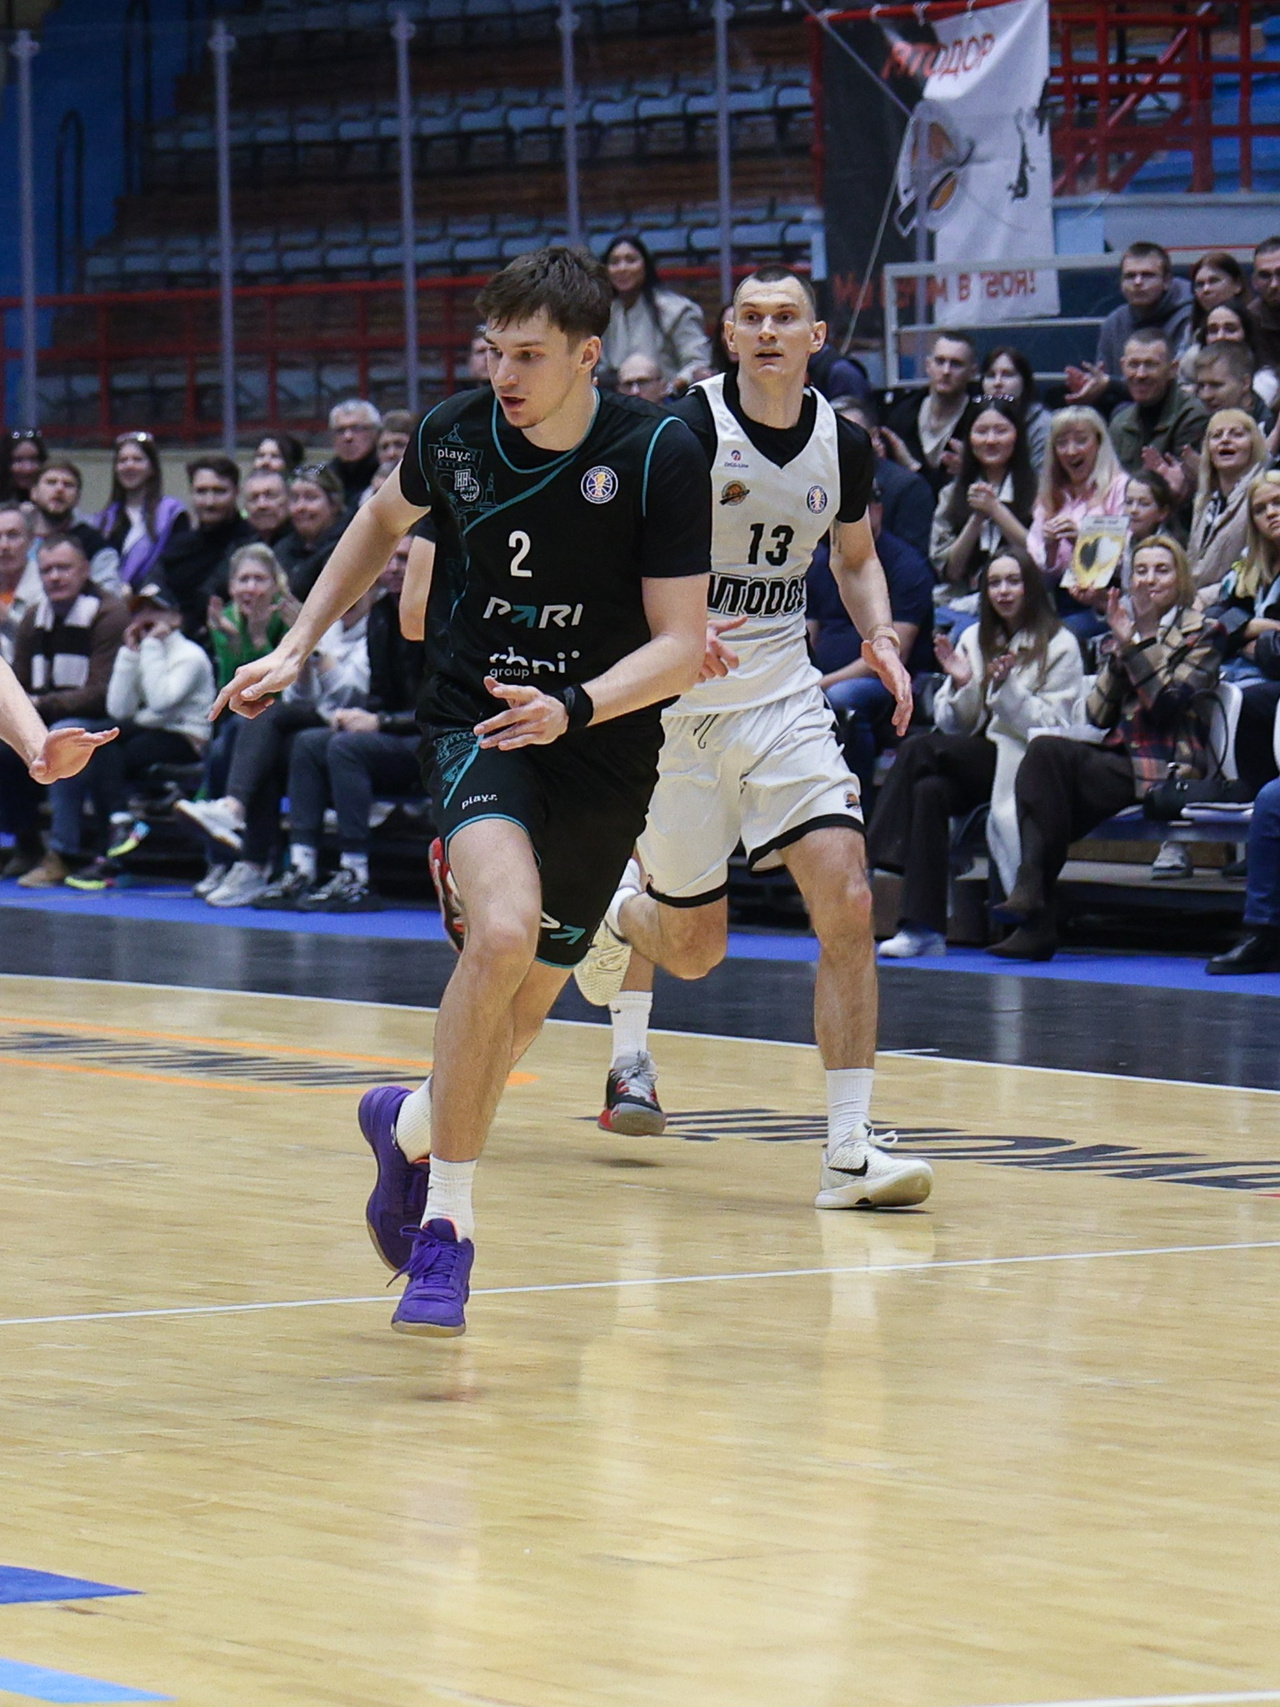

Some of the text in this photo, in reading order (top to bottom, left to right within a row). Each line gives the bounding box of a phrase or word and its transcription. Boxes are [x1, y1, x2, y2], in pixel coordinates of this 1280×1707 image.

[508, 530, 533, 578] 2
[748, 523, 795, 566] 13
[483, 596, 584, 629] PARI
[707, 571, 807, 619] VTODO
[489, 668, 530, 680] group
